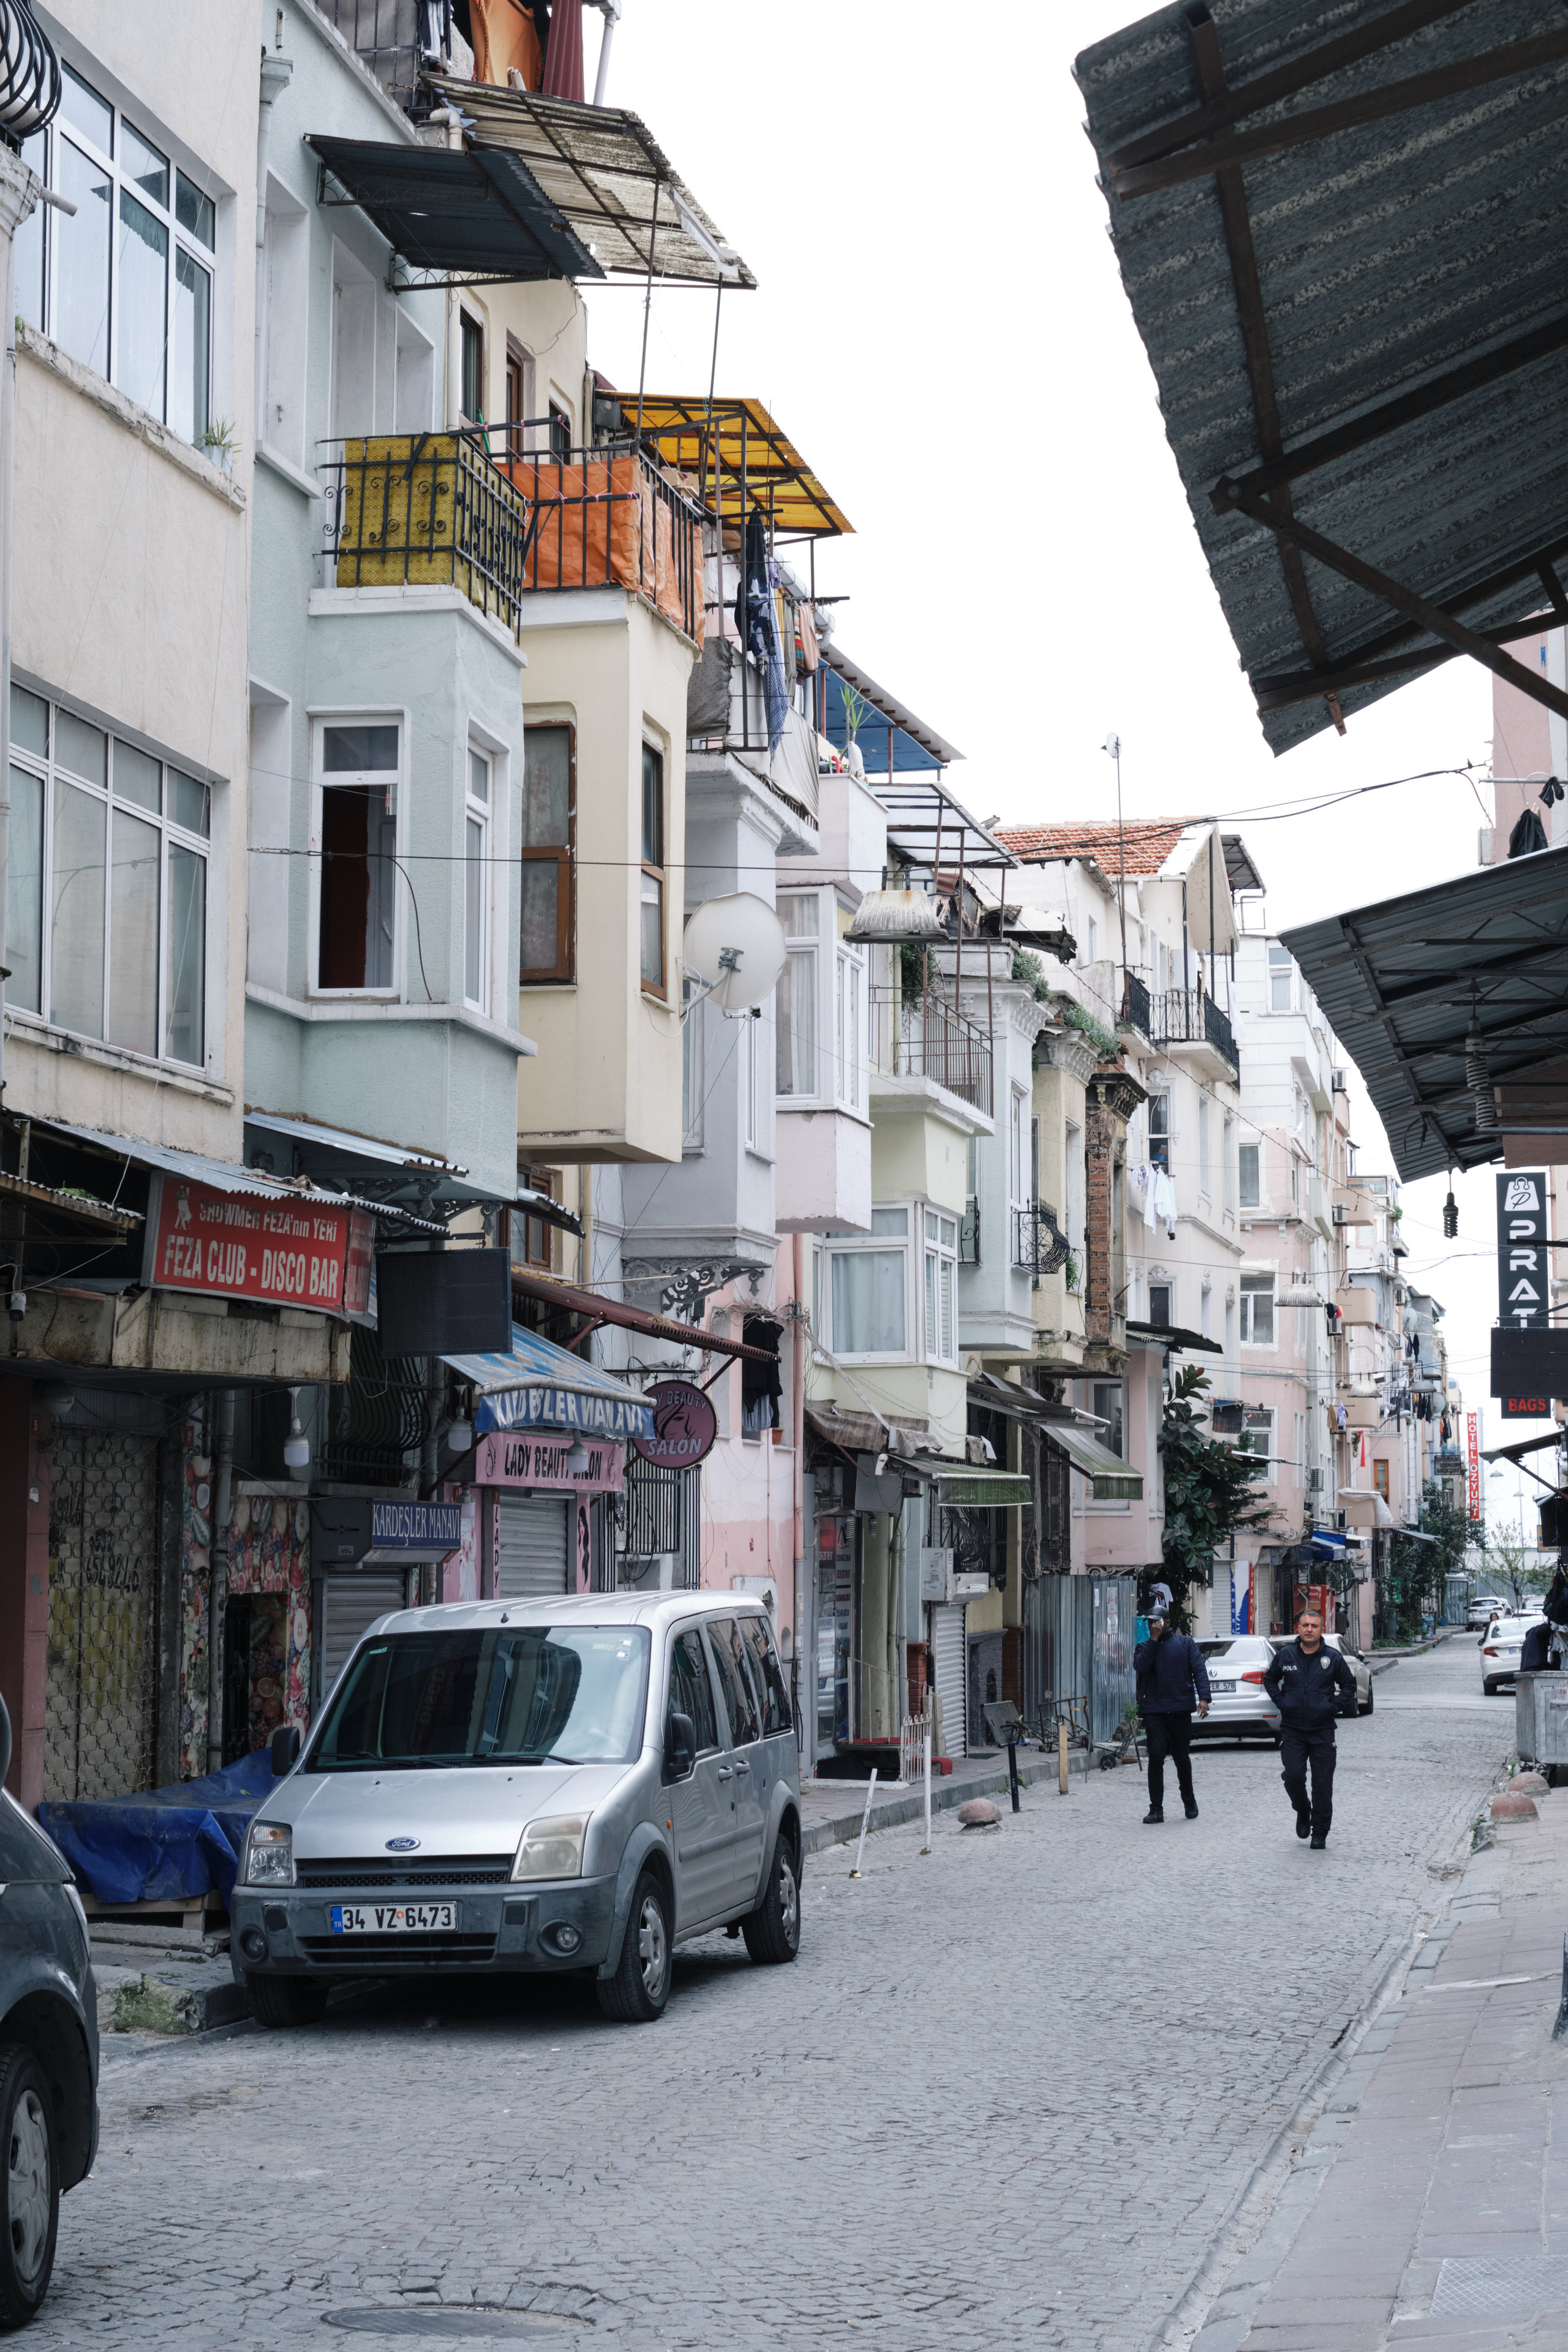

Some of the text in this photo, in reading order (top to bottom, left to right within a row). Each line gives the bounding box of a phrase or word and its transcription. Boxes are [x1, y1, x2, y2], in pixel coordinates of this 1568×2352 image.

[200, 1199, 260, 1230] SHOWMEN
[164, 1234, 202, 1280] FEZA
[207, 1240, 246, 1286] CLUB
[261, 1249, 306, 1294] DISCO
[309, 1256, 338, 1298] BAR
[666, 1390, 707, 1409] BEAUTY
[1509, 1398, 1547, 1412] BAGS
[34, 1419, 38, 1431] 5
[582, 1395, 643, 1433] MANAVI
[504, 1442, 532, 1477] LADY
[646, 1438, 703, 1457] SALON
[1468, 1415, 1479, 1516] HOTEL ÖZYURT
[372, 1504, 460, 1546] KARDEŞLER MANAVI
[391, 1838, 412, 1847] Ford
[343, 1909, 366, 1929] 34
[375, 1908, 398, 1929] VZ
[405, 1906, 451, 1928] 6473
